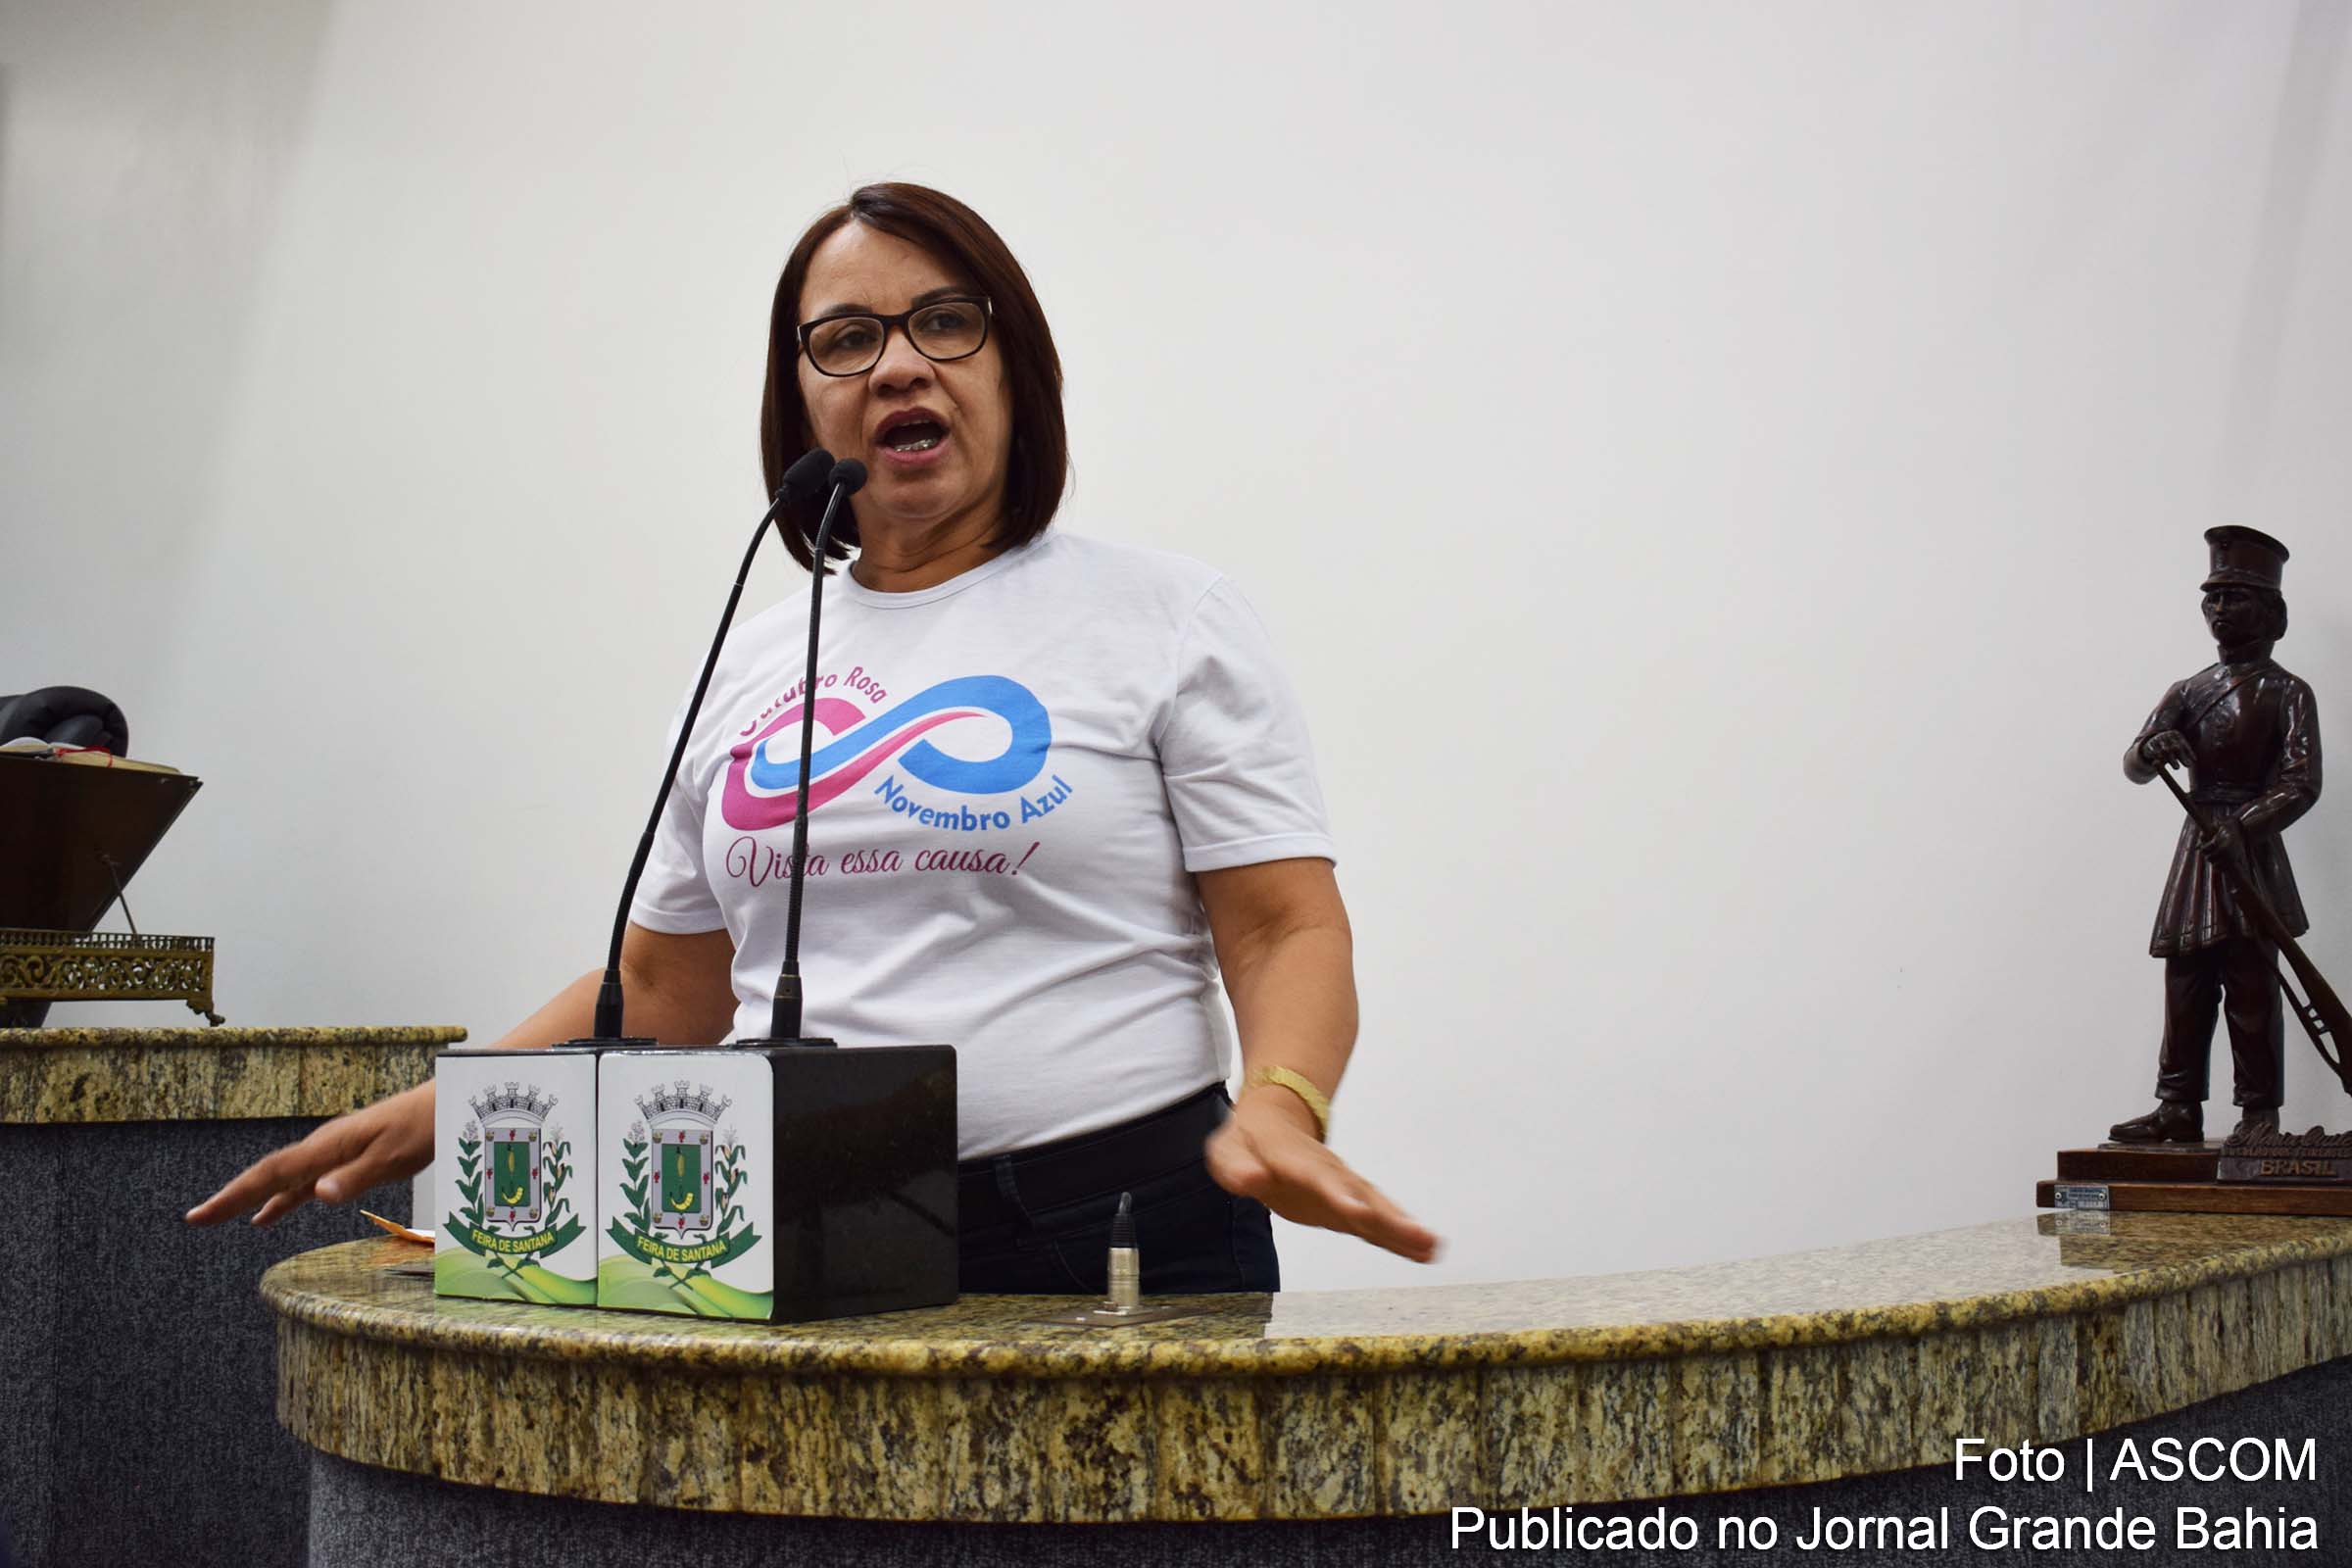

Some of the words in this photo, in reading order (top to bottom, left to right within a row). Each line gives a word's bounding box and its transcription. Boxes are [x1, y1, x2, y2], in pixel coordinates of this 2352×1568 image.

[843, 666, 887, 704] Rosa
[874, 774, 1010, 831] Novembro
[1020, 774, 1073, 824] Azul
[725, 836, 830, 888] Visa
[841, 849, 903, 874] essa
[914, 841, 1041, 875] causa!
[2260, 1159, 2336, 1176] BRASIL
[472, 1229, 498, 1250] FEIRA
[499, 1239, 511, 1251] DE
[513, 1232, 554, 1252] SANTANA
[637, 1236, 664, 1257] FEIRA
[666, 1247, 679, 1261] DE
[682, 1240, 726, 1261] SANTANA
